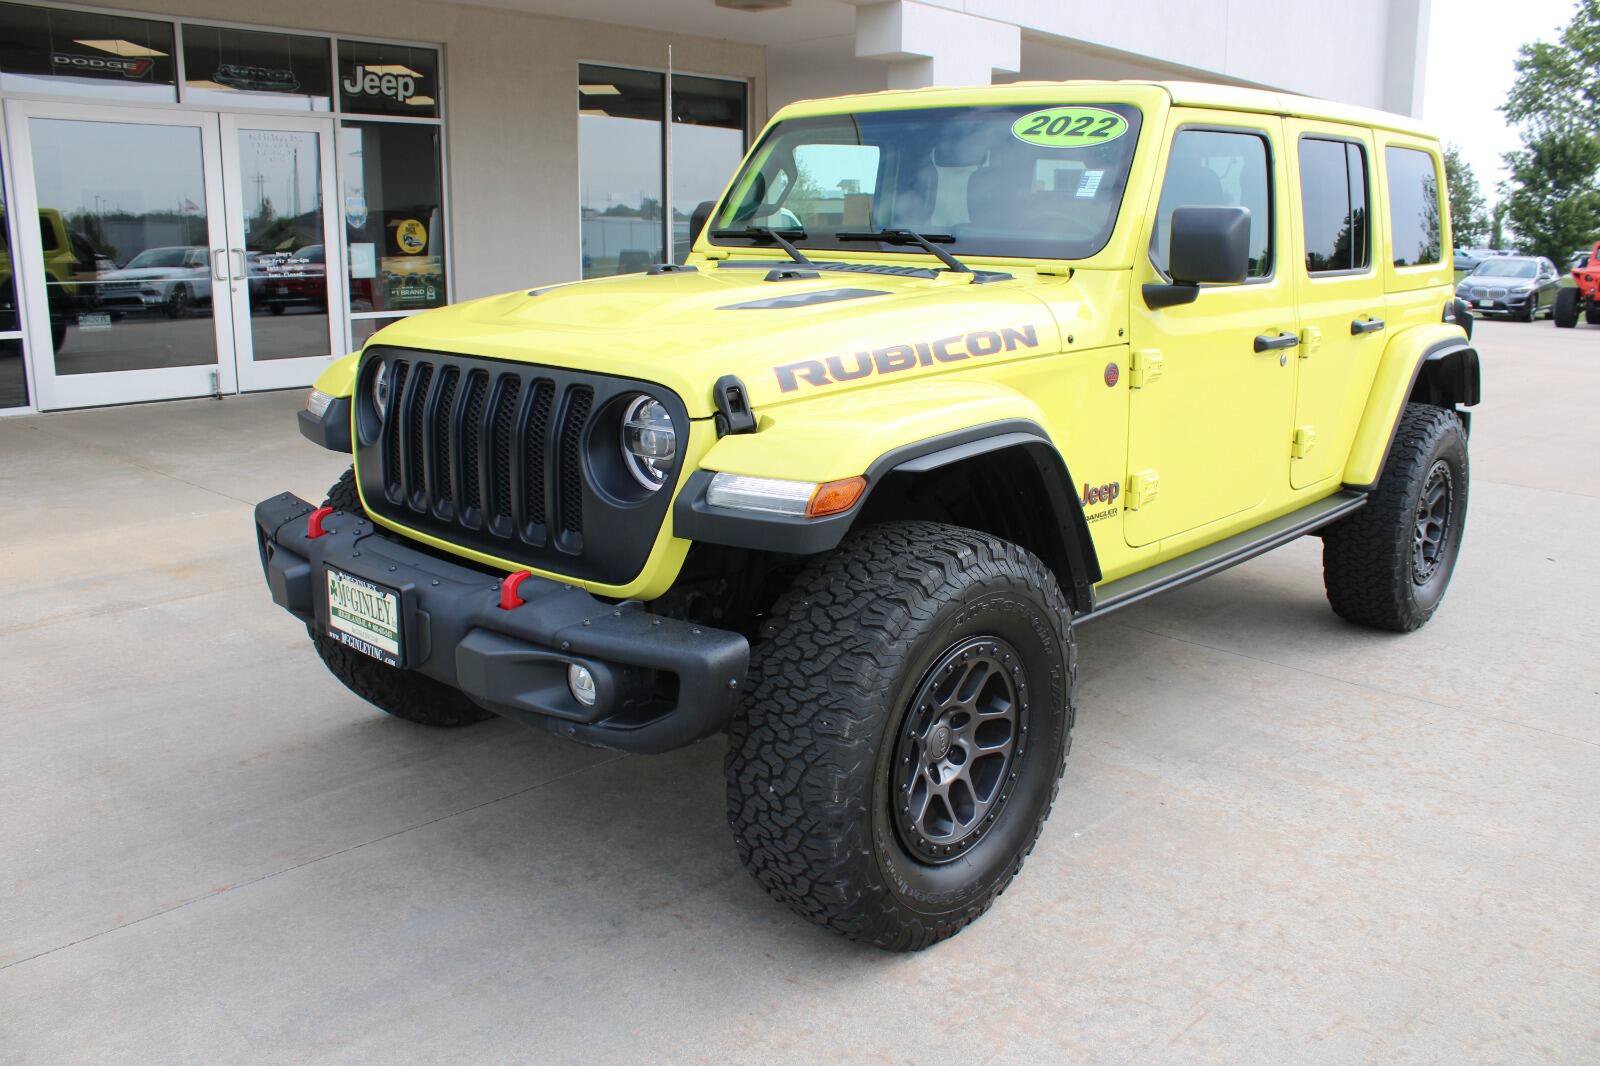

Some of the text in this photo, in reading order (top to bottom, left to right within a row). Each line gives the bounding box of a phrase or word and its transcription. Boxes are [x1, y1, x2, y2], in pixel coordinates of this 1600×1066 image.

[53, 56, 137, 70] DODGE
[342, 65, 416, 102] Jeep
[1021, 115, 1119, 137] 2022
[400, 288, 425, 297] BRAND
[773, 324, 1040, 393] RUBICON
[1079, 481, 1121, 508] Jeep
[336, 580, 392, 625] McGINLEY
